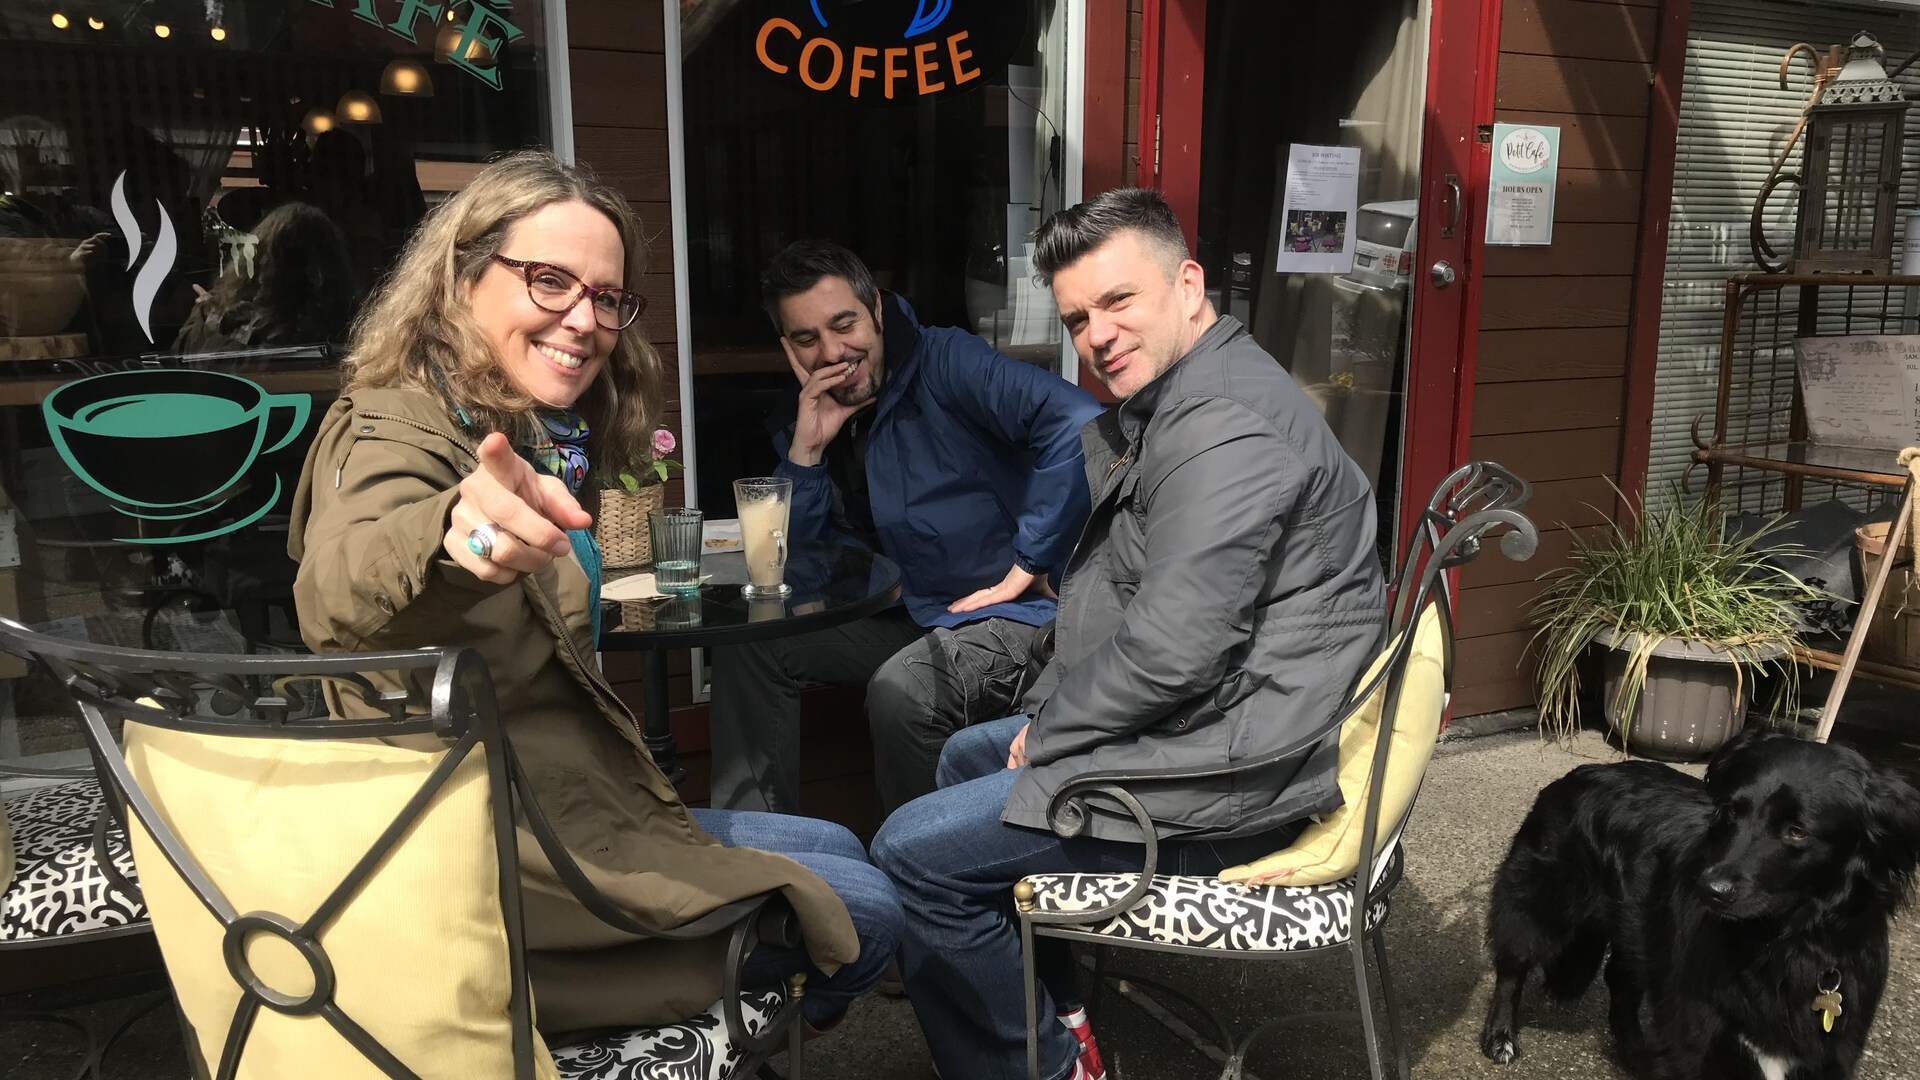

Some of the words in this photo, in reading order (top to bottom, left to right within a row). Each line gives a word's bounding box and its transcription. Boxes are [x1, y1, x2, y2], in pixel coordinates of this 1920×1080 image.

[756, 18, 981, 99] COFFEE
[1502, 185, 1525, 193] HOURS
[1526, 186, 1543, 194] OPEN
